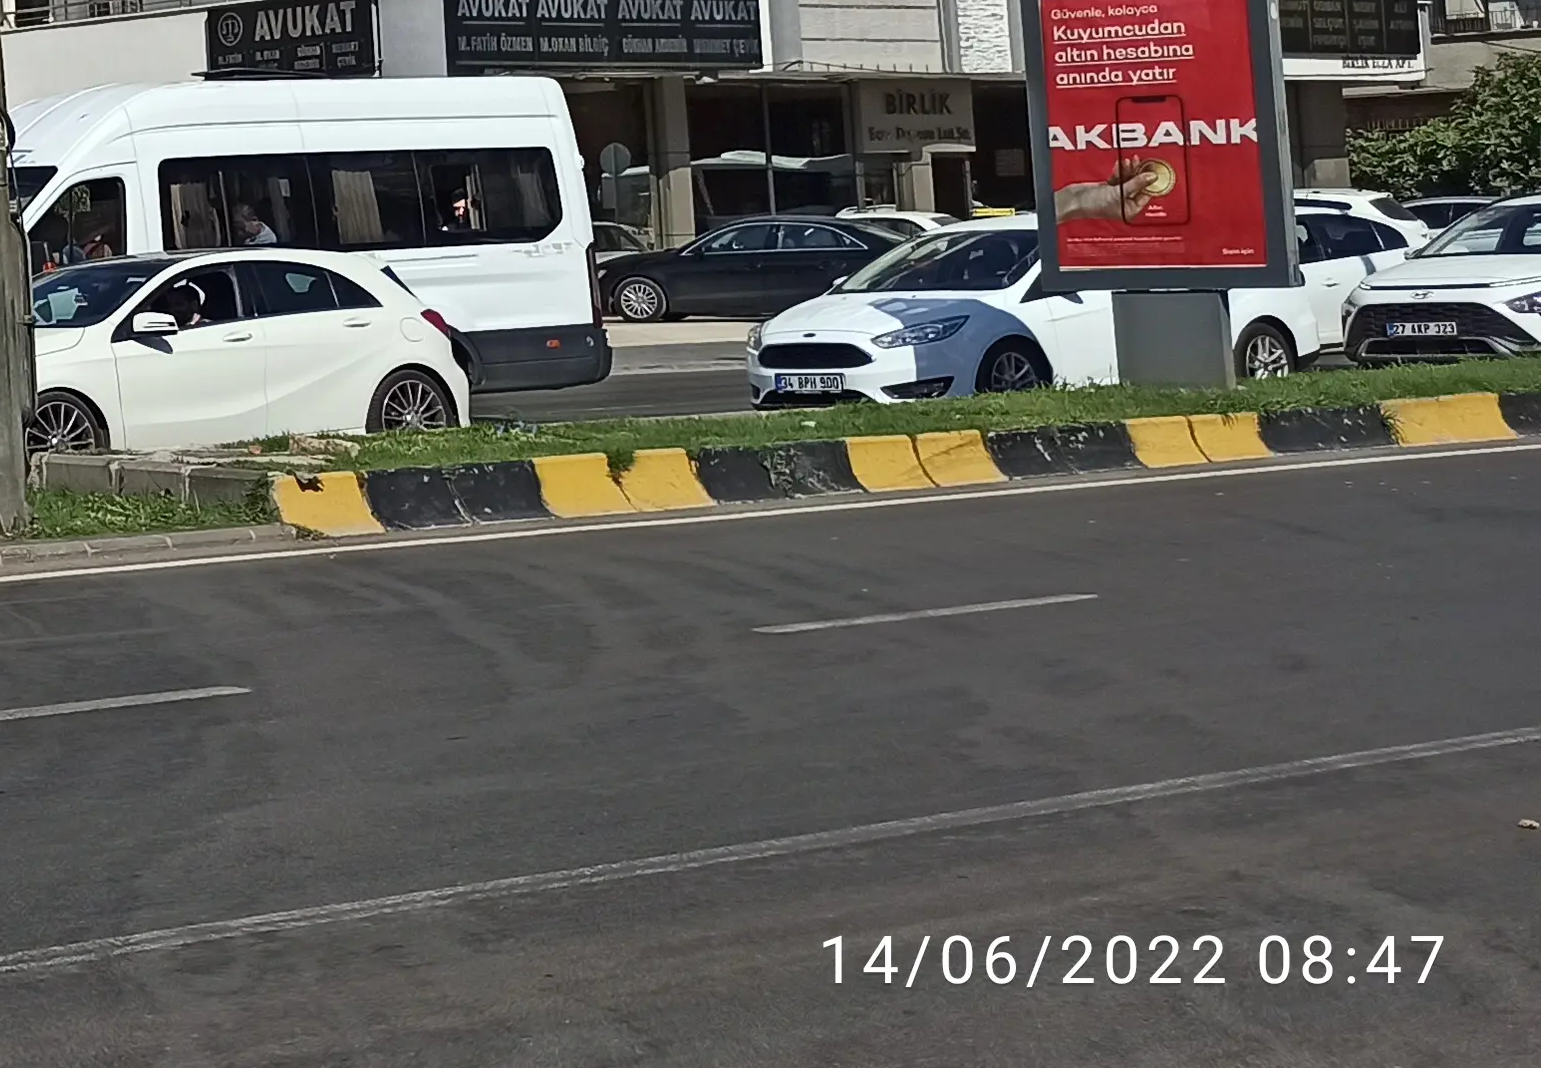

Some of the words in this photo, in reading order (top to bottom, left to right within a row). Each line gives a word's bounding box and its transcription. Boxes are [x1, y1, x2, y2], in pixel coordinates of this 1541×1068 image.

[255, 0, 356, 41] AVUKAT
[617, 0, 684, 20] AVUKAT
[690, 0, 757, 21] AVUKAT
[1051, 8, 1105, 20] Güvenle,
[1108, 5, 1157, 18] kolayca
[1053, 19, 1185, 43] Kuyumcudan
[1055, 45, 1098, 63] altın
[1103, 41, 1194, 60] hesabına
[1056, 67, 1122, 85] anında
[1128, 65, 1177, 85] yatır
[1048, 118, 1258, 151] AKBANK
[781, 376, 794, 389] 34
